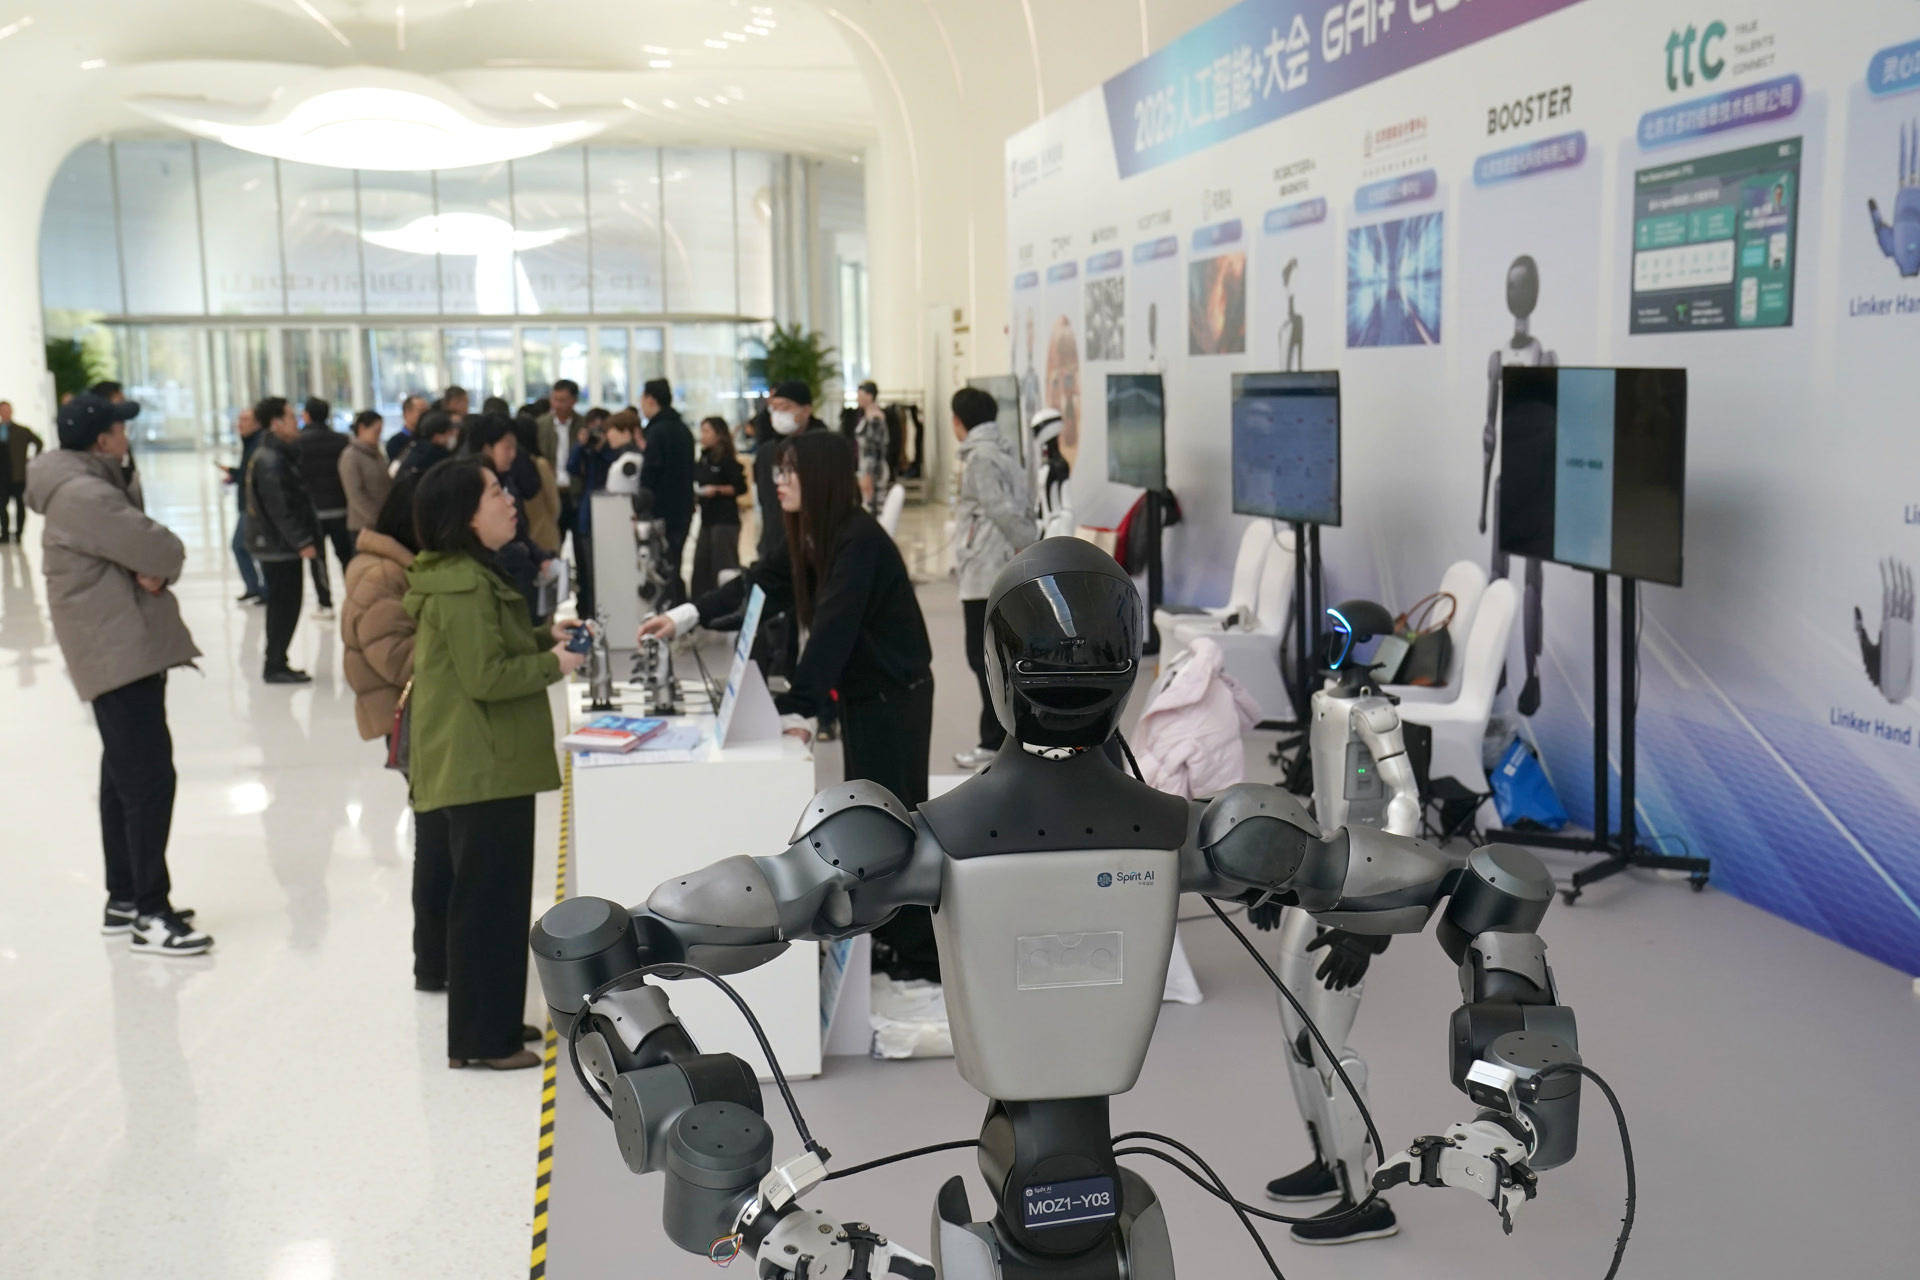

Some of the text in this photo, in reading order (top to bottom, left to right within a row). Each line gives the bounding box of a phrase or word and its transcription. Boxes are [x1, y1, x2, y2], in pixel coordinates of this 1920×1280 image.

[1487, 83, 1572, 136] BOOSTER
[1849, 294, 1893, 317] Linker
[1829, 706, 1871, 734] Linker
[1874, 717, 1912, 746] Hand
[1116, 871, 1142, 884] Spirit
[1144, 870, 1155, 881] AI
[1028, 1191, 1110, 1216] MOZ1-Y03
